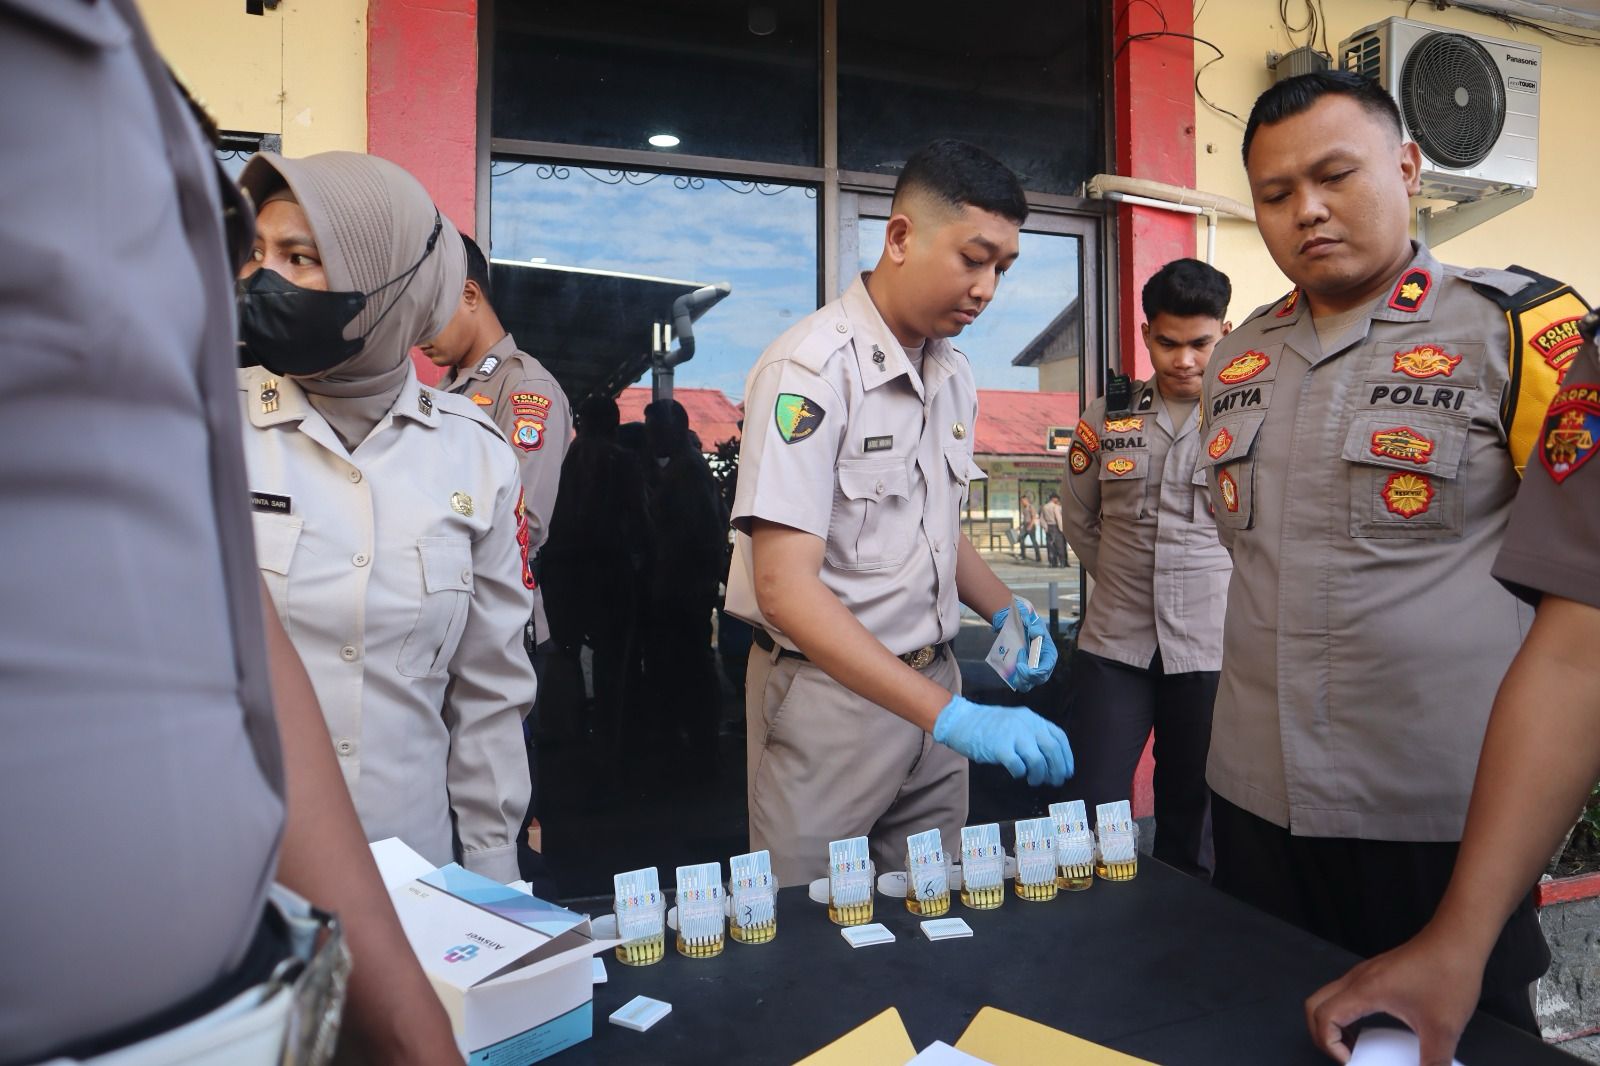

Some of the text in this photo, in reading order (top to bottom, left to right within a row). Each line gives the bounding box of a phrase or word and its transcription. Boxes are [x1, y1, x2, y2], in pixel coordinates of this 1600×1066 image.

[1506, 54, 1538, 66] Panasonic
[1538, 319, 1582, 348] POLRE
[1545, 327, 1581, 349] TARAKA
[513, 394, 549, 405] POLRES
[1213, 387, 1262, 417] SATYA
[1370, 385, 1465, 411] POLRI
[1554, 388, 1600, 405] PROPA
[1101, 437, 1147, 452] IQBAL
[271, 500, 286, 508] SARI
[924, 881, 935, 898] 6
[744, 905, 753, 927] 3
[464, 931, 505, 951] Answer
